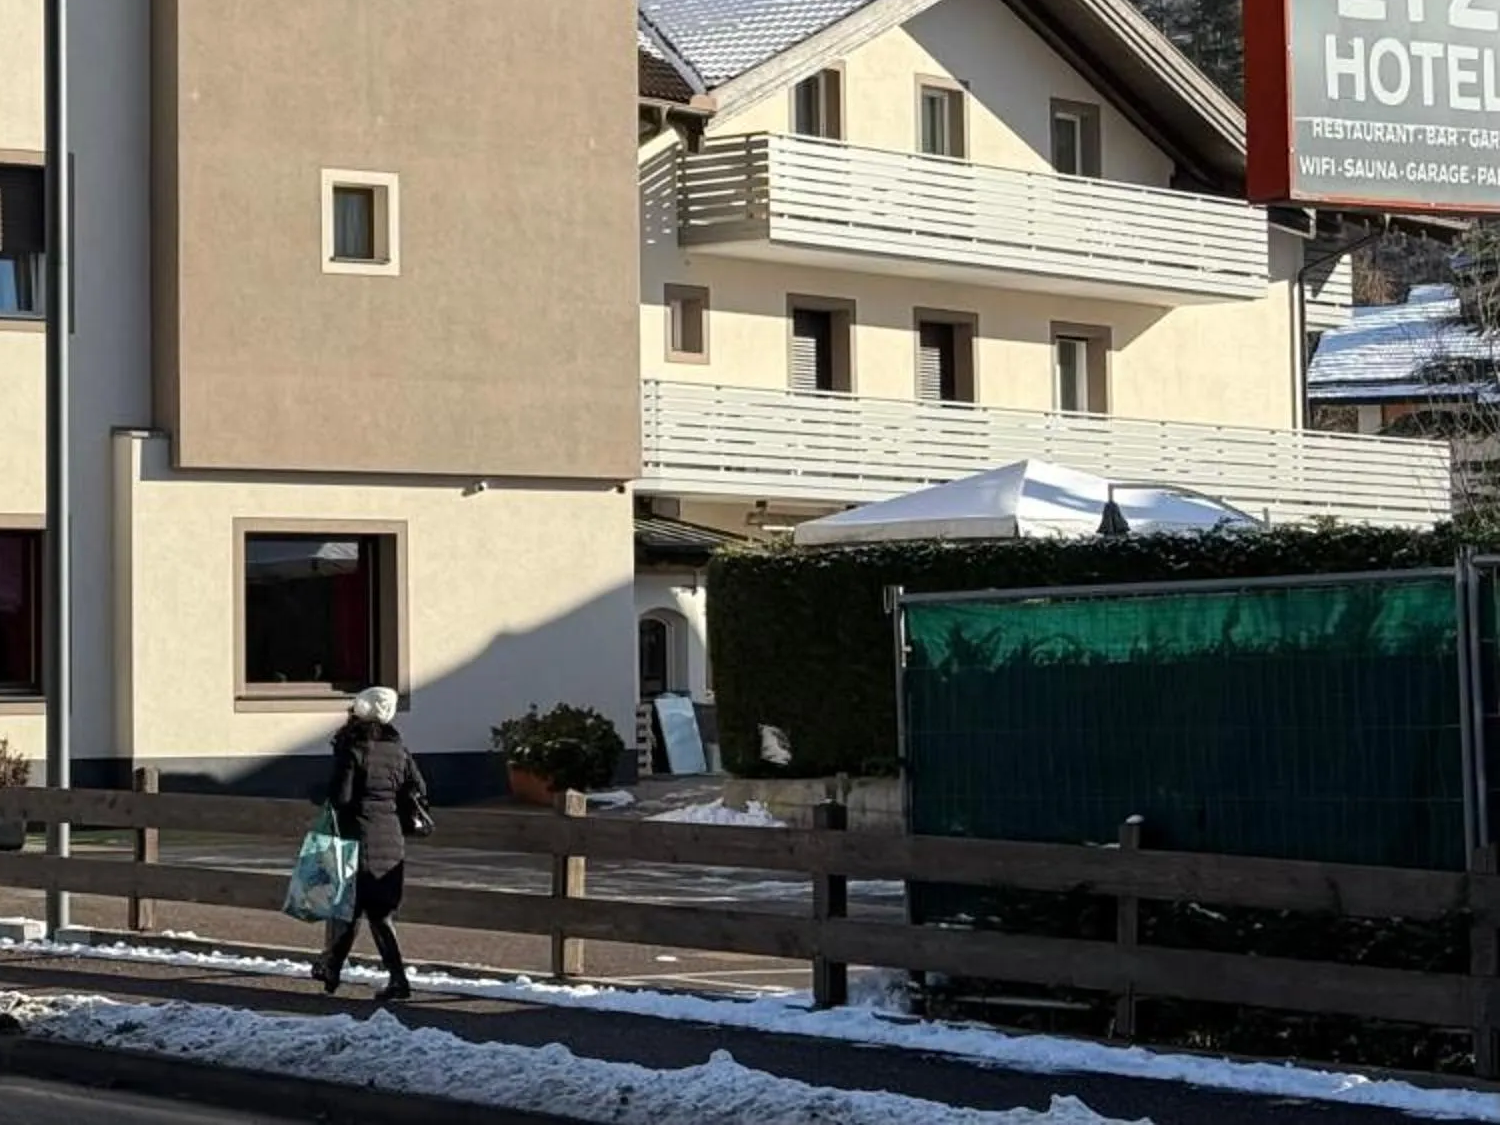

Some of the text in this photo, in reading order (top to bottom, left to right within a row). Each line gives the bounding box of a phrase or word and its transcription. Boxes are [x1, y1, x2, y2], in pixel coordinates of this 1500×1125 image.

[1325, 33, 1500, 113] HOTEL
[1312, 118, 1416, 144] RESTAURANT
[1426, 125, 1458, 147] BAR
[1300, 155, 1500, 187] WIFI SAUNA GARAGE PA
